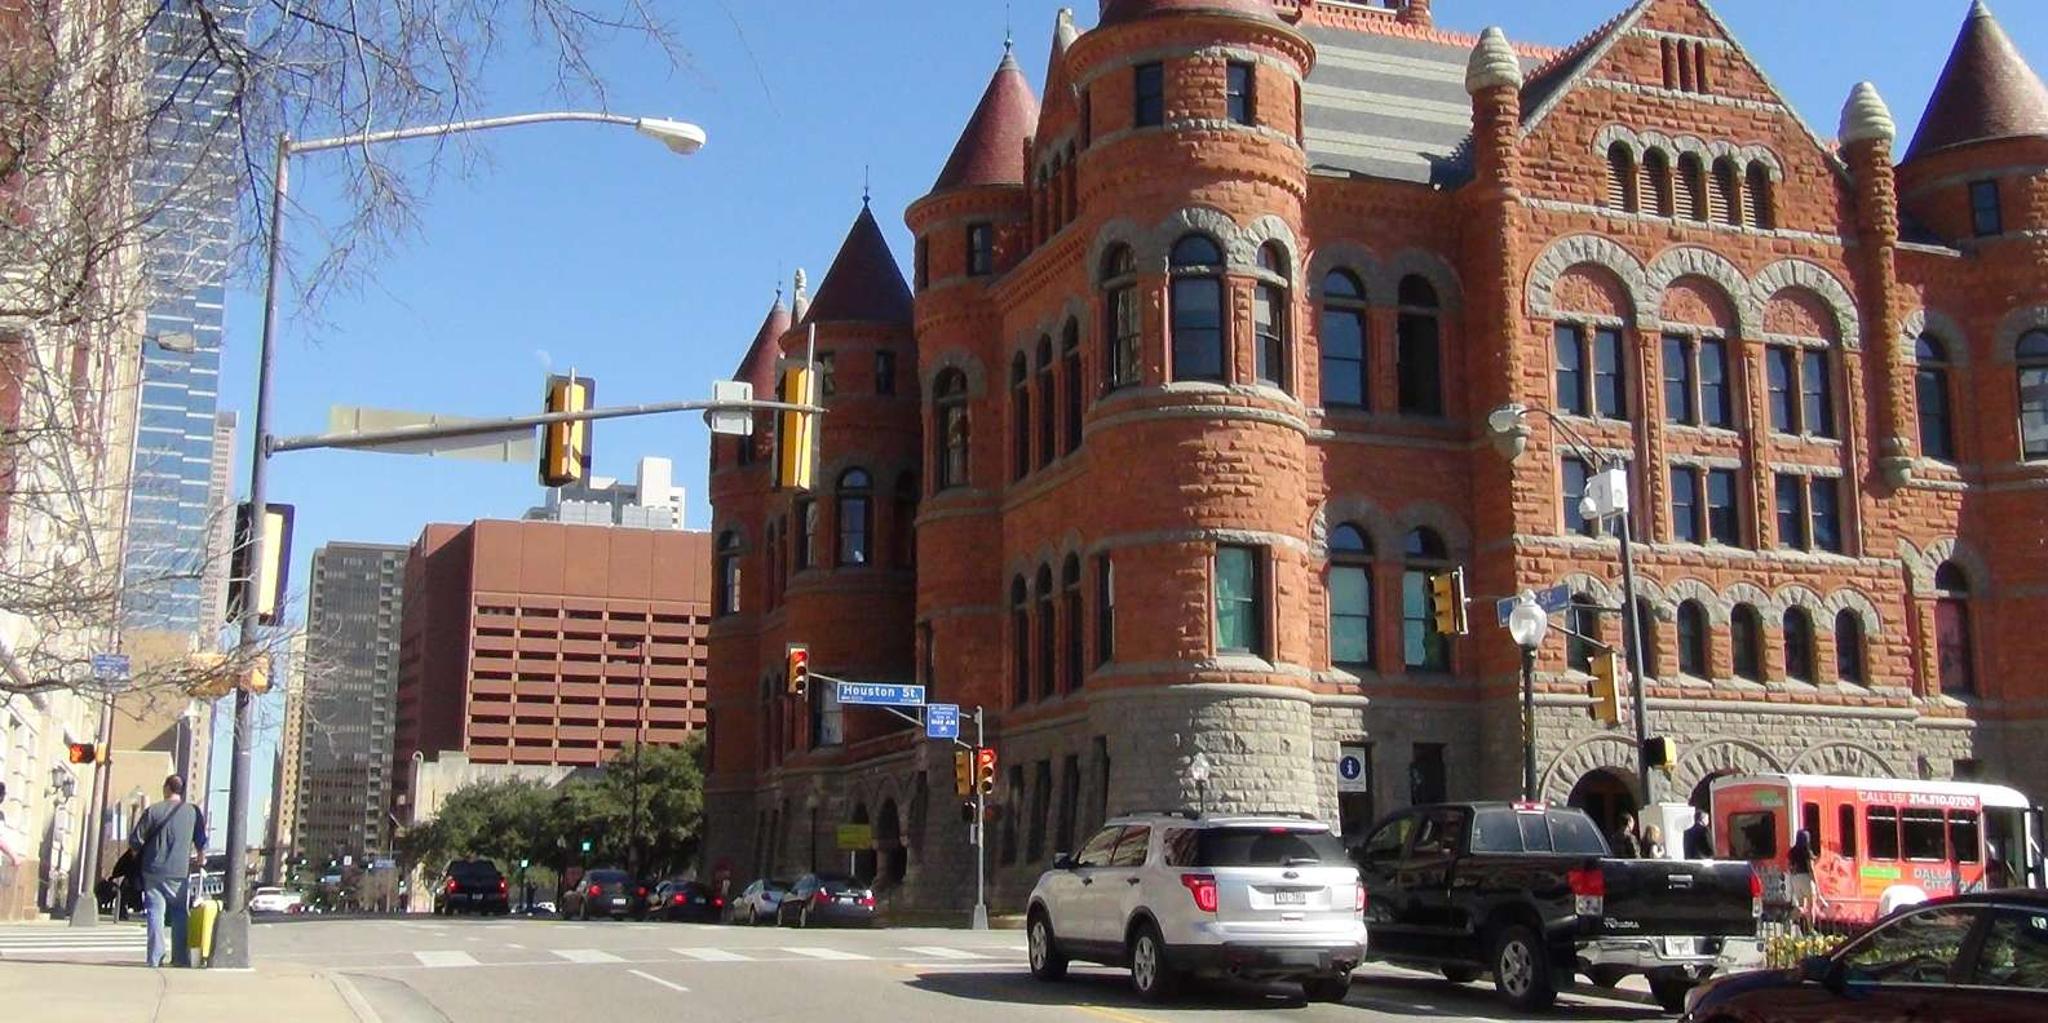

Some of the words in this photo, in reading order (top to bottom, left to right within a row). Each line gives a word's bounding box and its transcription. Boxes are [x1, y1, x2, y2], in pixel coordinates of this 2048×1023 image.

[843, 685, 895, 697] Houston
[902, 688, 919, 699] St.
[1858, 790, 1886, 802] CALL
